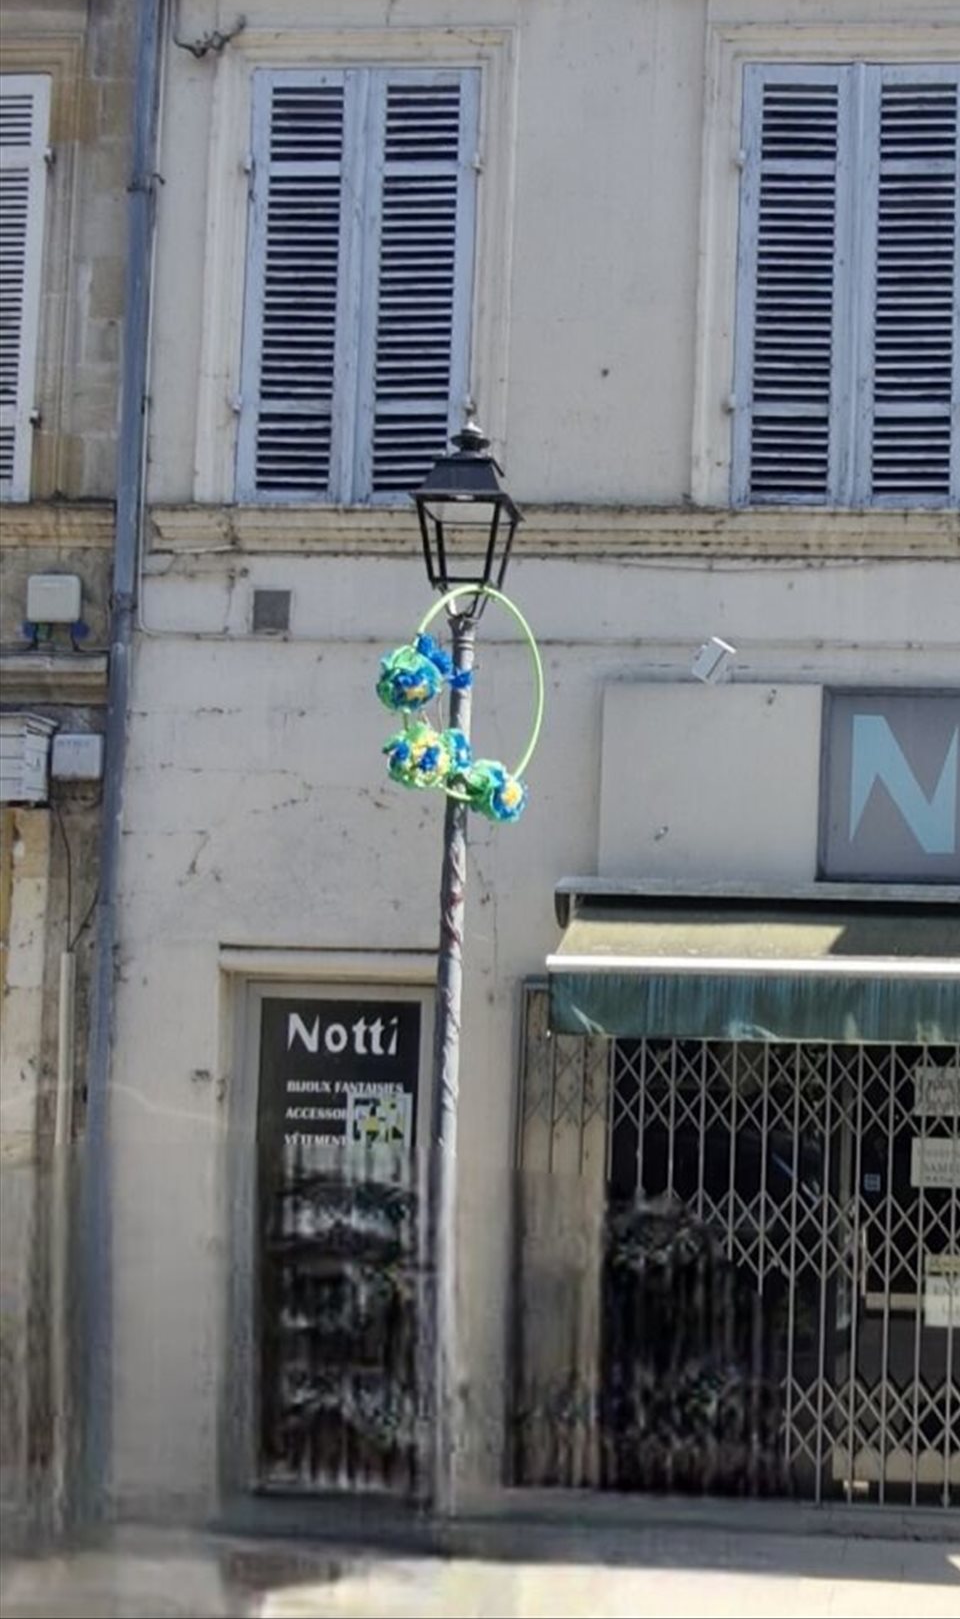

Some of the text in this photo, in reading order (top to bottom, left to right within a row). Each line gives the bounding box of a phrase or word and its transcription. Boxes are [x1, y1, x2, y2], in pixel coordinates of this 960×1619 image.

[287, 1012, 399, 1055] Notti
[287, 1080, 404, 1094] BIJOUX FANTAISIES
